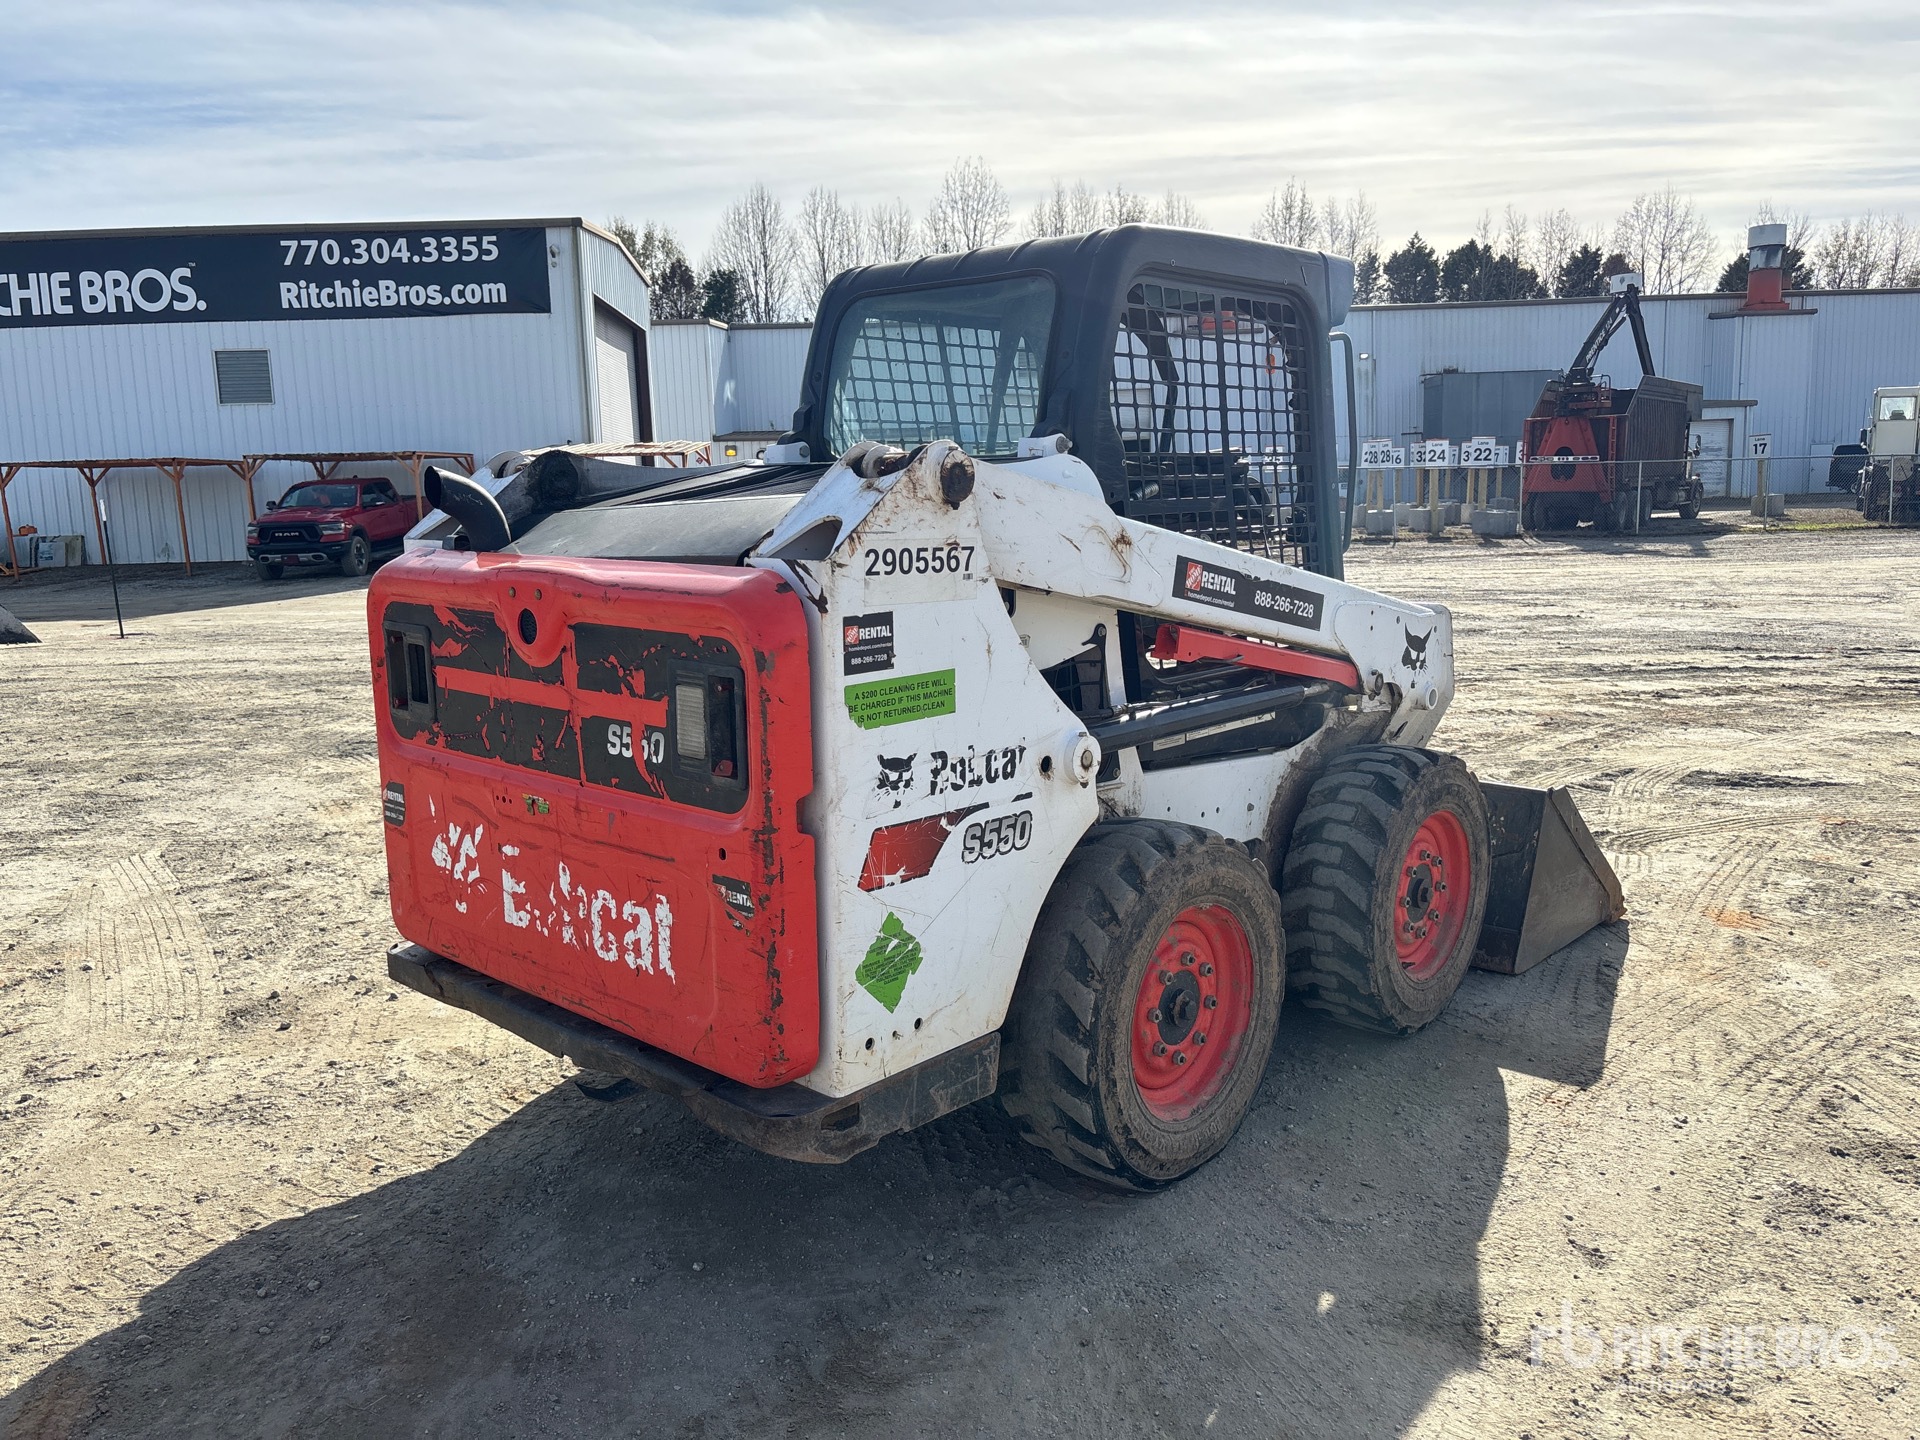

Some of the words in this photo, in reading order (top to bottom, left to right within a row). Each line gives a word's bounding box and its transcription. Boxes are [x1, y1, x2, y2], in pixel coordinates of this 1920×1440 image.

[280, 235, 499, 266] 770.304.3355
[79, 266, 208, 315] BROS.
[279, 278, 508, 309] RitchieBros.com
[1368, 450, 1378, 464] 28
[1380, 449, 1391, 464] 28
[1391, 453, 1402, 465] 16
[1428, 449, 1447, 463] 24
[1473, 447, 1492, 462] 22
[1752, 442, 1768, 454] 17
[864, 545, 975, 577] 2905567
[1201, 570, 1237, 595] RENTAL
[1187, 591, 1235, 608] homedepot.com/rental
[1254, 590, 1315, 618] 888-266-7228
[858, 624, 893, 640] RENTAL
[850, 653, 888, 665] 888-266-7228
[848, 704, 860, 714] BE
[860, 697, 897, 711] CHARGED
[897, 697, 905, 705] IF
[905, 694, 922, 703] THIS
[922, 687, 953, 700] MACHINE
[854, 692, 860, 701] A
[861, 690, 878, 700] $200
[879, 682, 916, 697] CLEANING
[916, 680, 931, 690] FEE
[931, 678, 948, 688] WILL
[857, 715, 865, 723] IS
[866, 712, 882, 722] NOT
[883, 705, 924, 719] RETURNED
[923, 700, 945, 711] CLEAN
[961, 810, 1033, 864] S550
